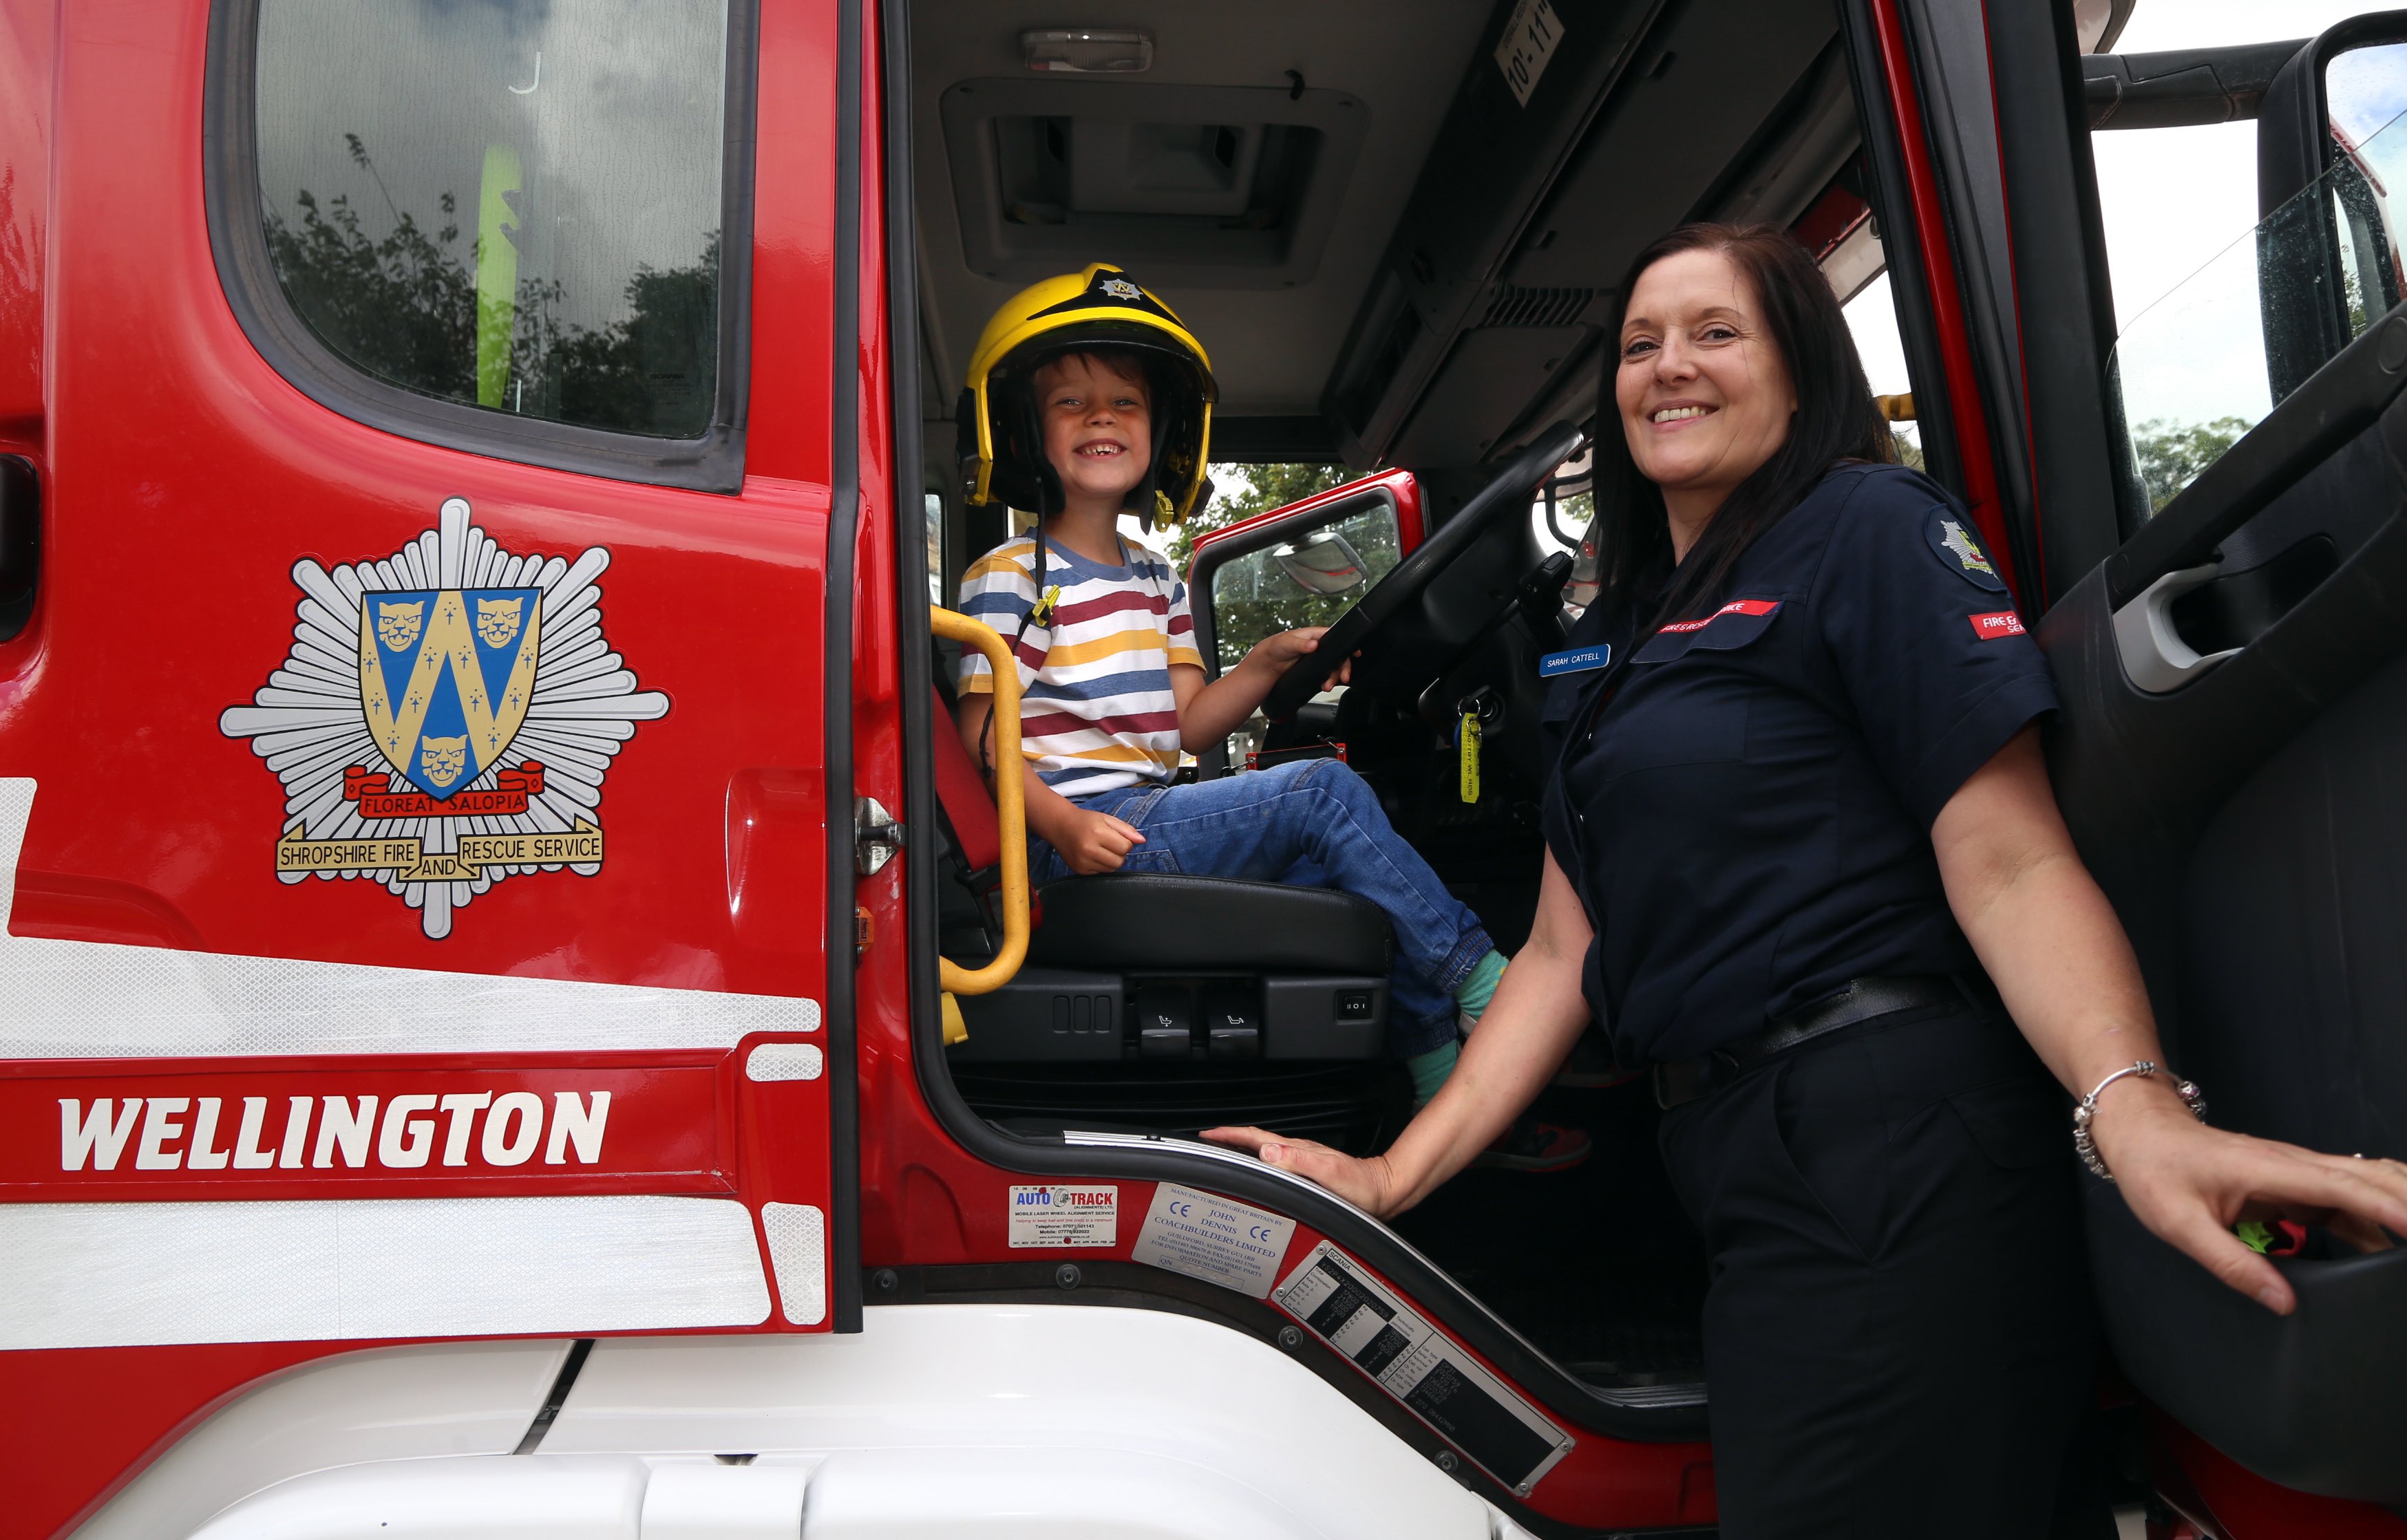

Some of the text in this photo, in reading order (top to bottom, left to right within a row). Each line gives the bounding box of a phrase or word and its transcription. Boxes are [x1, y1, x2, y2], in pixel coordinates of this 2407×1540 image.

[1983, 617, 2006, 628] FIRE
[1547, 652, 1600, 667] SARAH CATTELL
[364, 794, 526, 813] FLOREAT SALOPIA
[280, 838, 600, 876] SHROPSHIRE FIRE AND RESCUE SERVICE
[58, 1091, 611, 1171] WELLINGTON
[1017, 1193, 1113, 1205] AUTO TRACK
[1171, 1188, 1220, 1206] MANUFACTURED
[1229, 1206, 1249, 1215] GREAT
[1251, 1212, 1274, 1223] BRITAIN
[1209, 1210, 1236, 1223] JOHN
[1201, 1219, 1238, 1234] DENNIS
[1154, 1216, 1276, 1258] COACHBUILDERS LIMITED
[1207, 1243, 1229, 1253] SURREY
[1165, 1244, 1208, 1260] INFORMATION
[1224, 1262, 1242, 1270] SPARE
[1244, 1268, 1262, 1277] PARTS
[1180, 1255, 1229, 1273] QUOTE NUMBER
[1328, 1251, 1350, 1270] SCANIA
